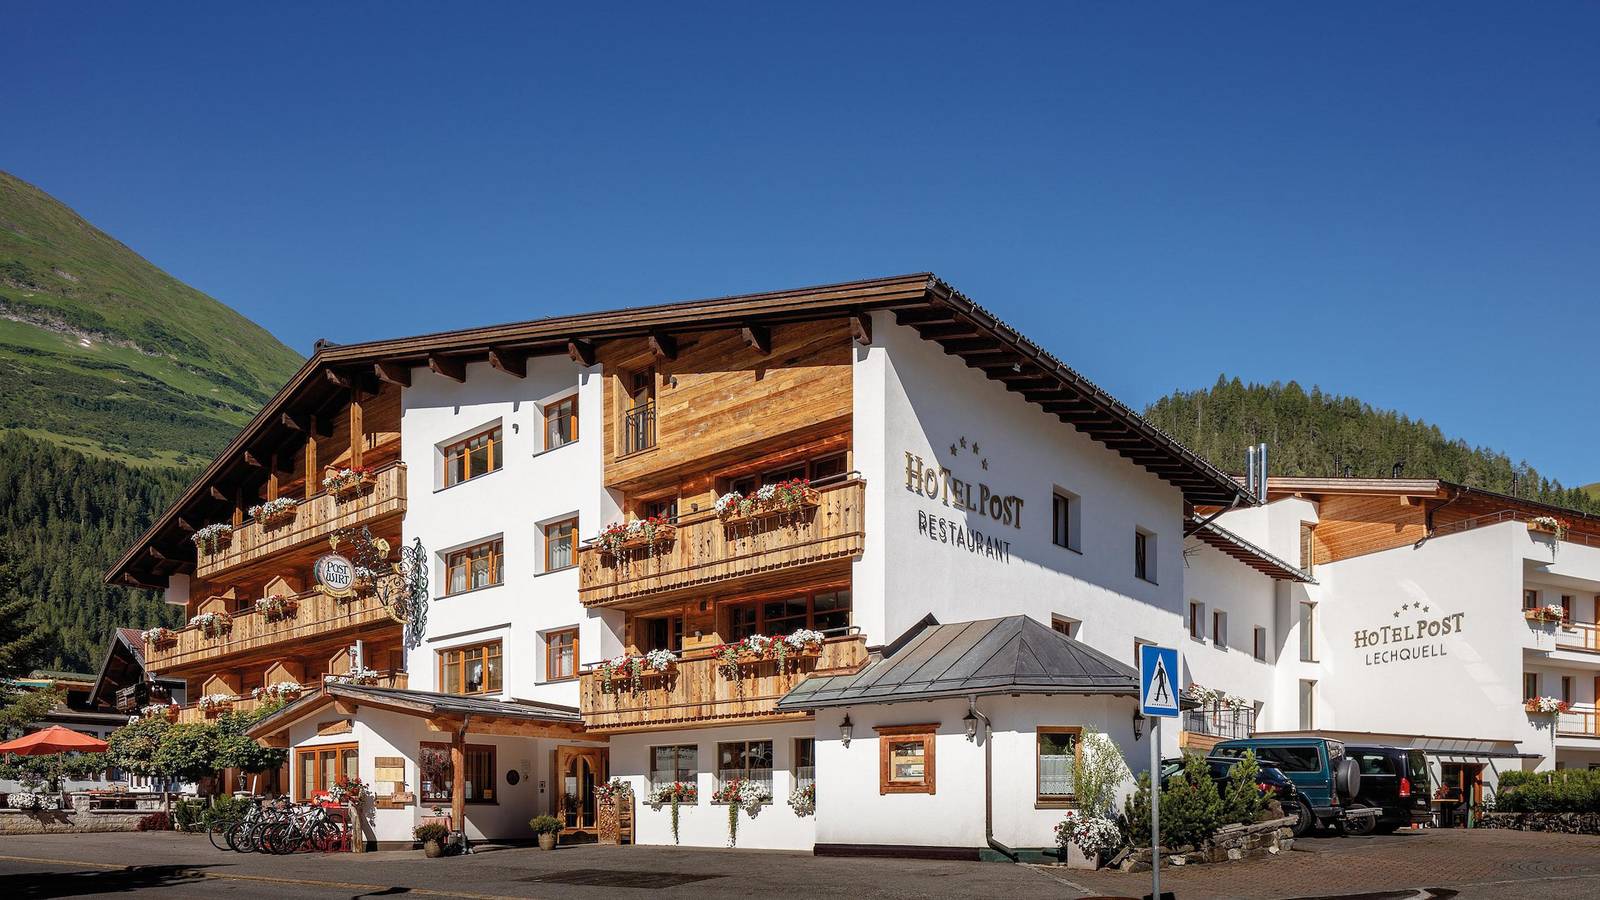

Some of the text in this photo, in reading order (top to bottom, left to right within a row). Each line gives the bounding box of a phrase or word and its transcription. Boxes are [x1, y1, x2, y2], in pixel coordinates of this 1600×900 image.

[979, 483, 1024, 529] POST
[918, 509, 1011, 564] RESTAURANT
[327, 561, 348, 574] POST
[1416, 612, 1465, 639] POST
[1365, 643, 1448, 666] LECHQUELL
